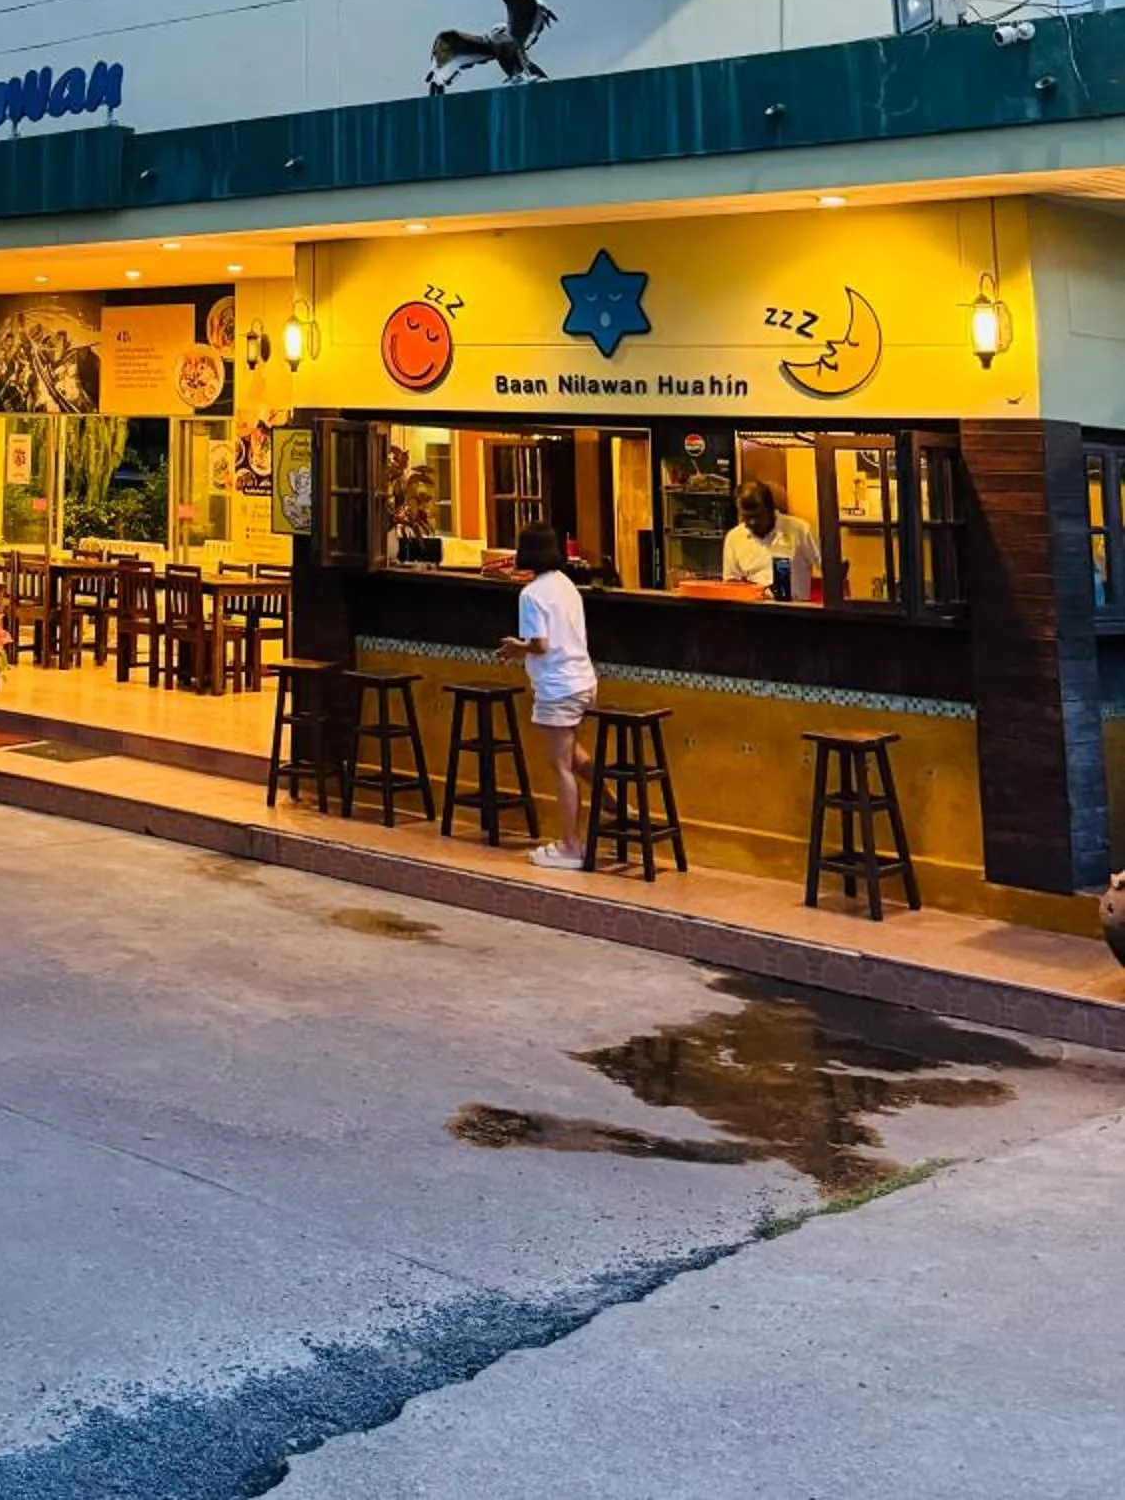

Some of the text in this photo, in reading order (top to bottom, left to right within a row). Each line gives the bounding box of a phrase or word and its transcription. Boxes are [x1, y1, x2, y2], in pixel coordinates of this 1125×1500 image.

[495, 373, 748, 395] Baan Nilawan Huahin
